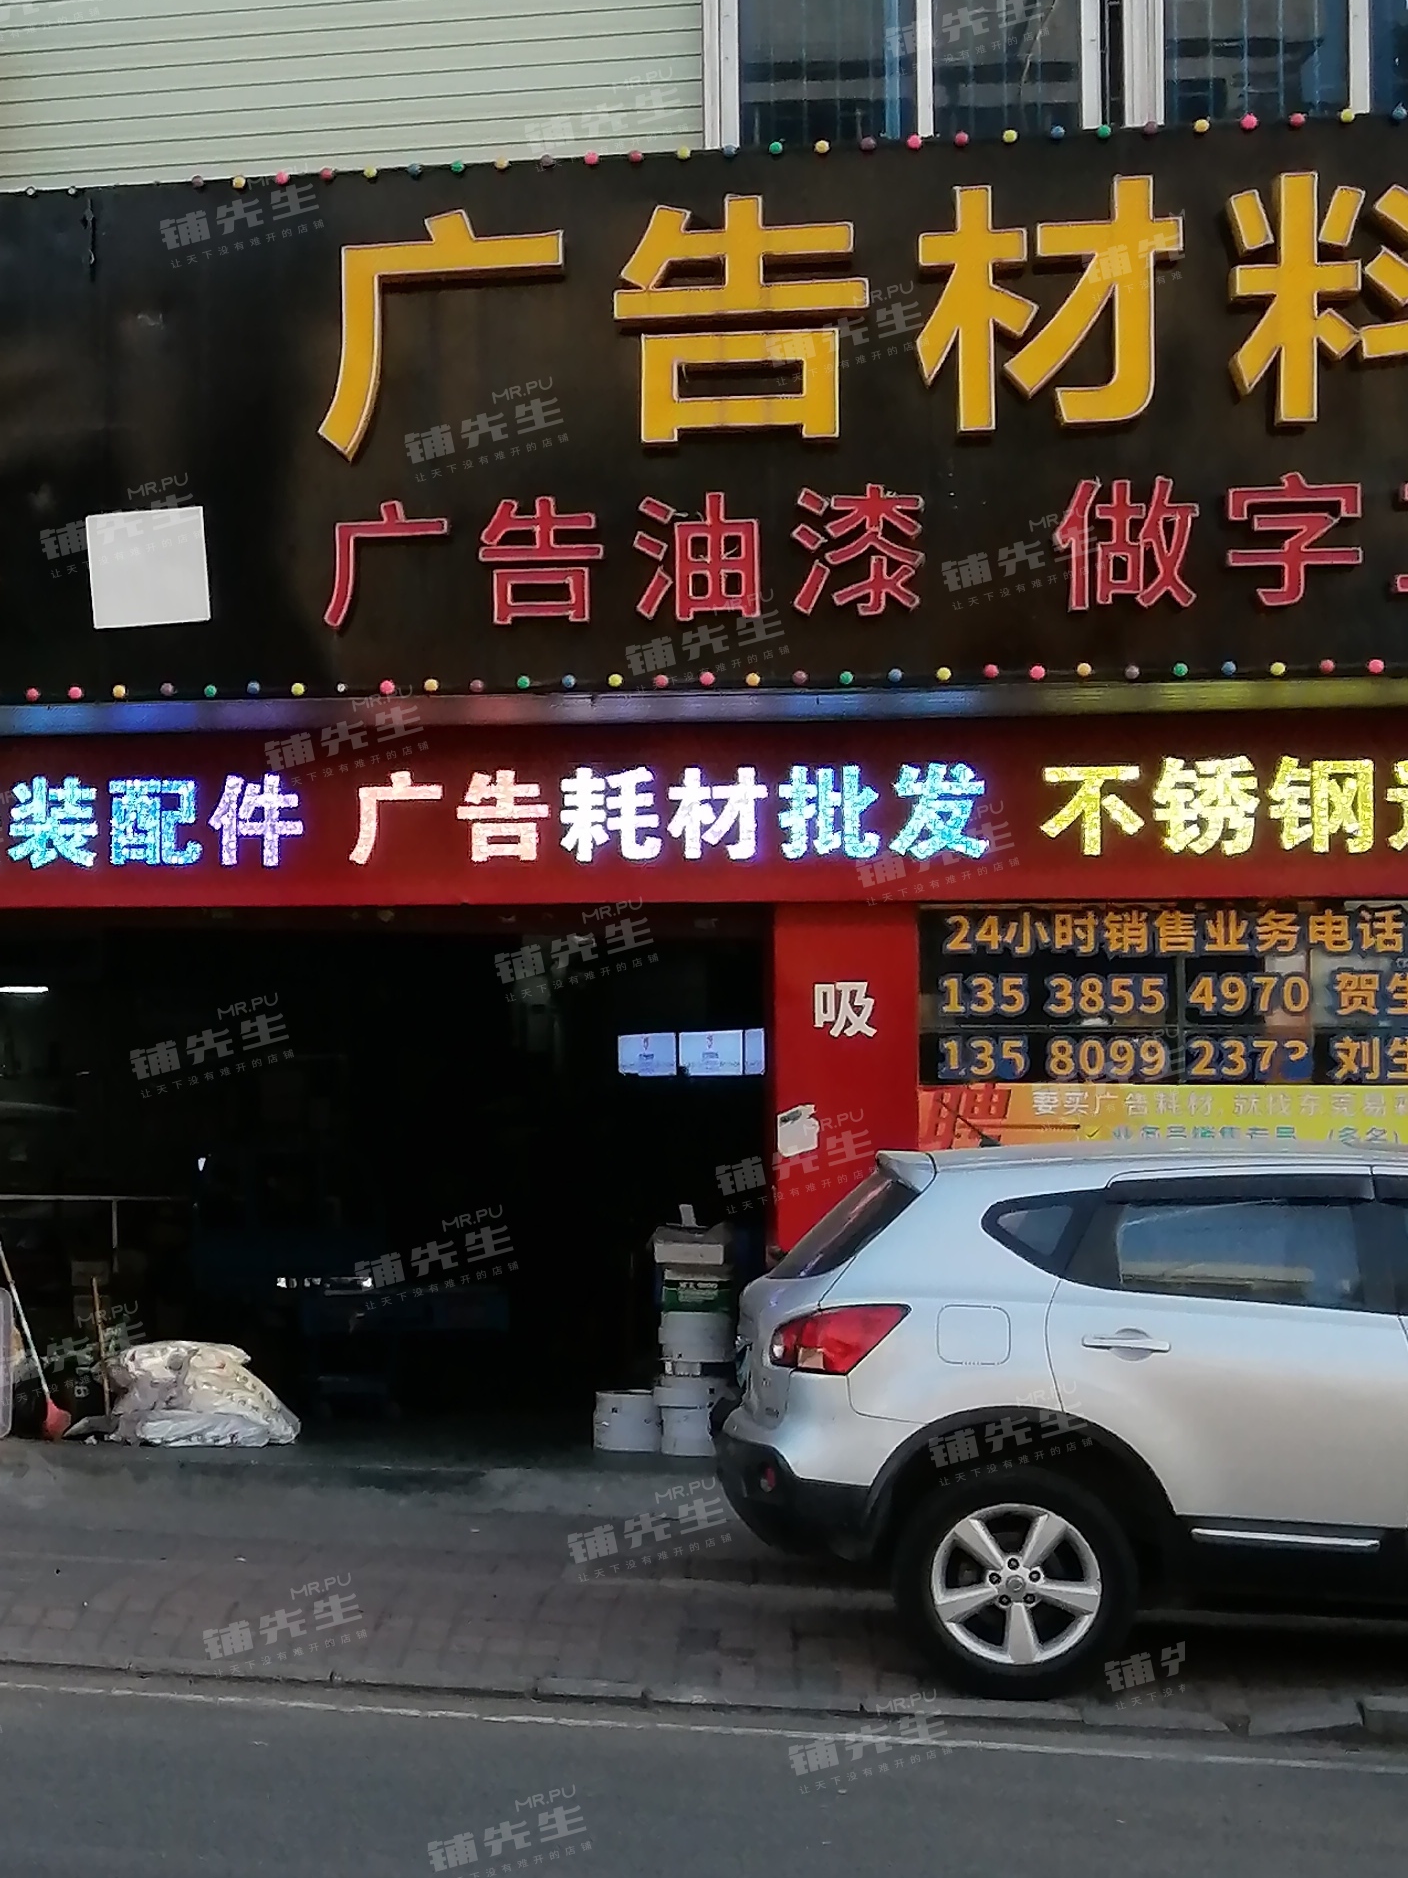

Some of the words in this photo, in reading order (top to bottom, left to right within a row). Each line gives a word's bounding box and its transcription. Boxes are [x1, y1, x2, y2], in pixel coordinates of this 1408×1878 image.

[318, 172, 1408, 461] 广告材料
[324, 484, 924, 629] 广告油漆
[1056, 472, 1408, 611] 做字
[349, 760, 991, 867] 广告耗材批发
[1039, 753, 1408, 860] 不锈钢
[945, 908, 1407, 956] 24小时销售业务电话
[812, 978, 878, 1038] 吸
[939, 975, 1026, 1014] 135
[1047, 974, 1167, 1014] 3855
[1187, 973, 1311, 1014] 4970
[938, 1036, 1027, 1079] 135
[1048, 1037, 1167, 1078] 8099
